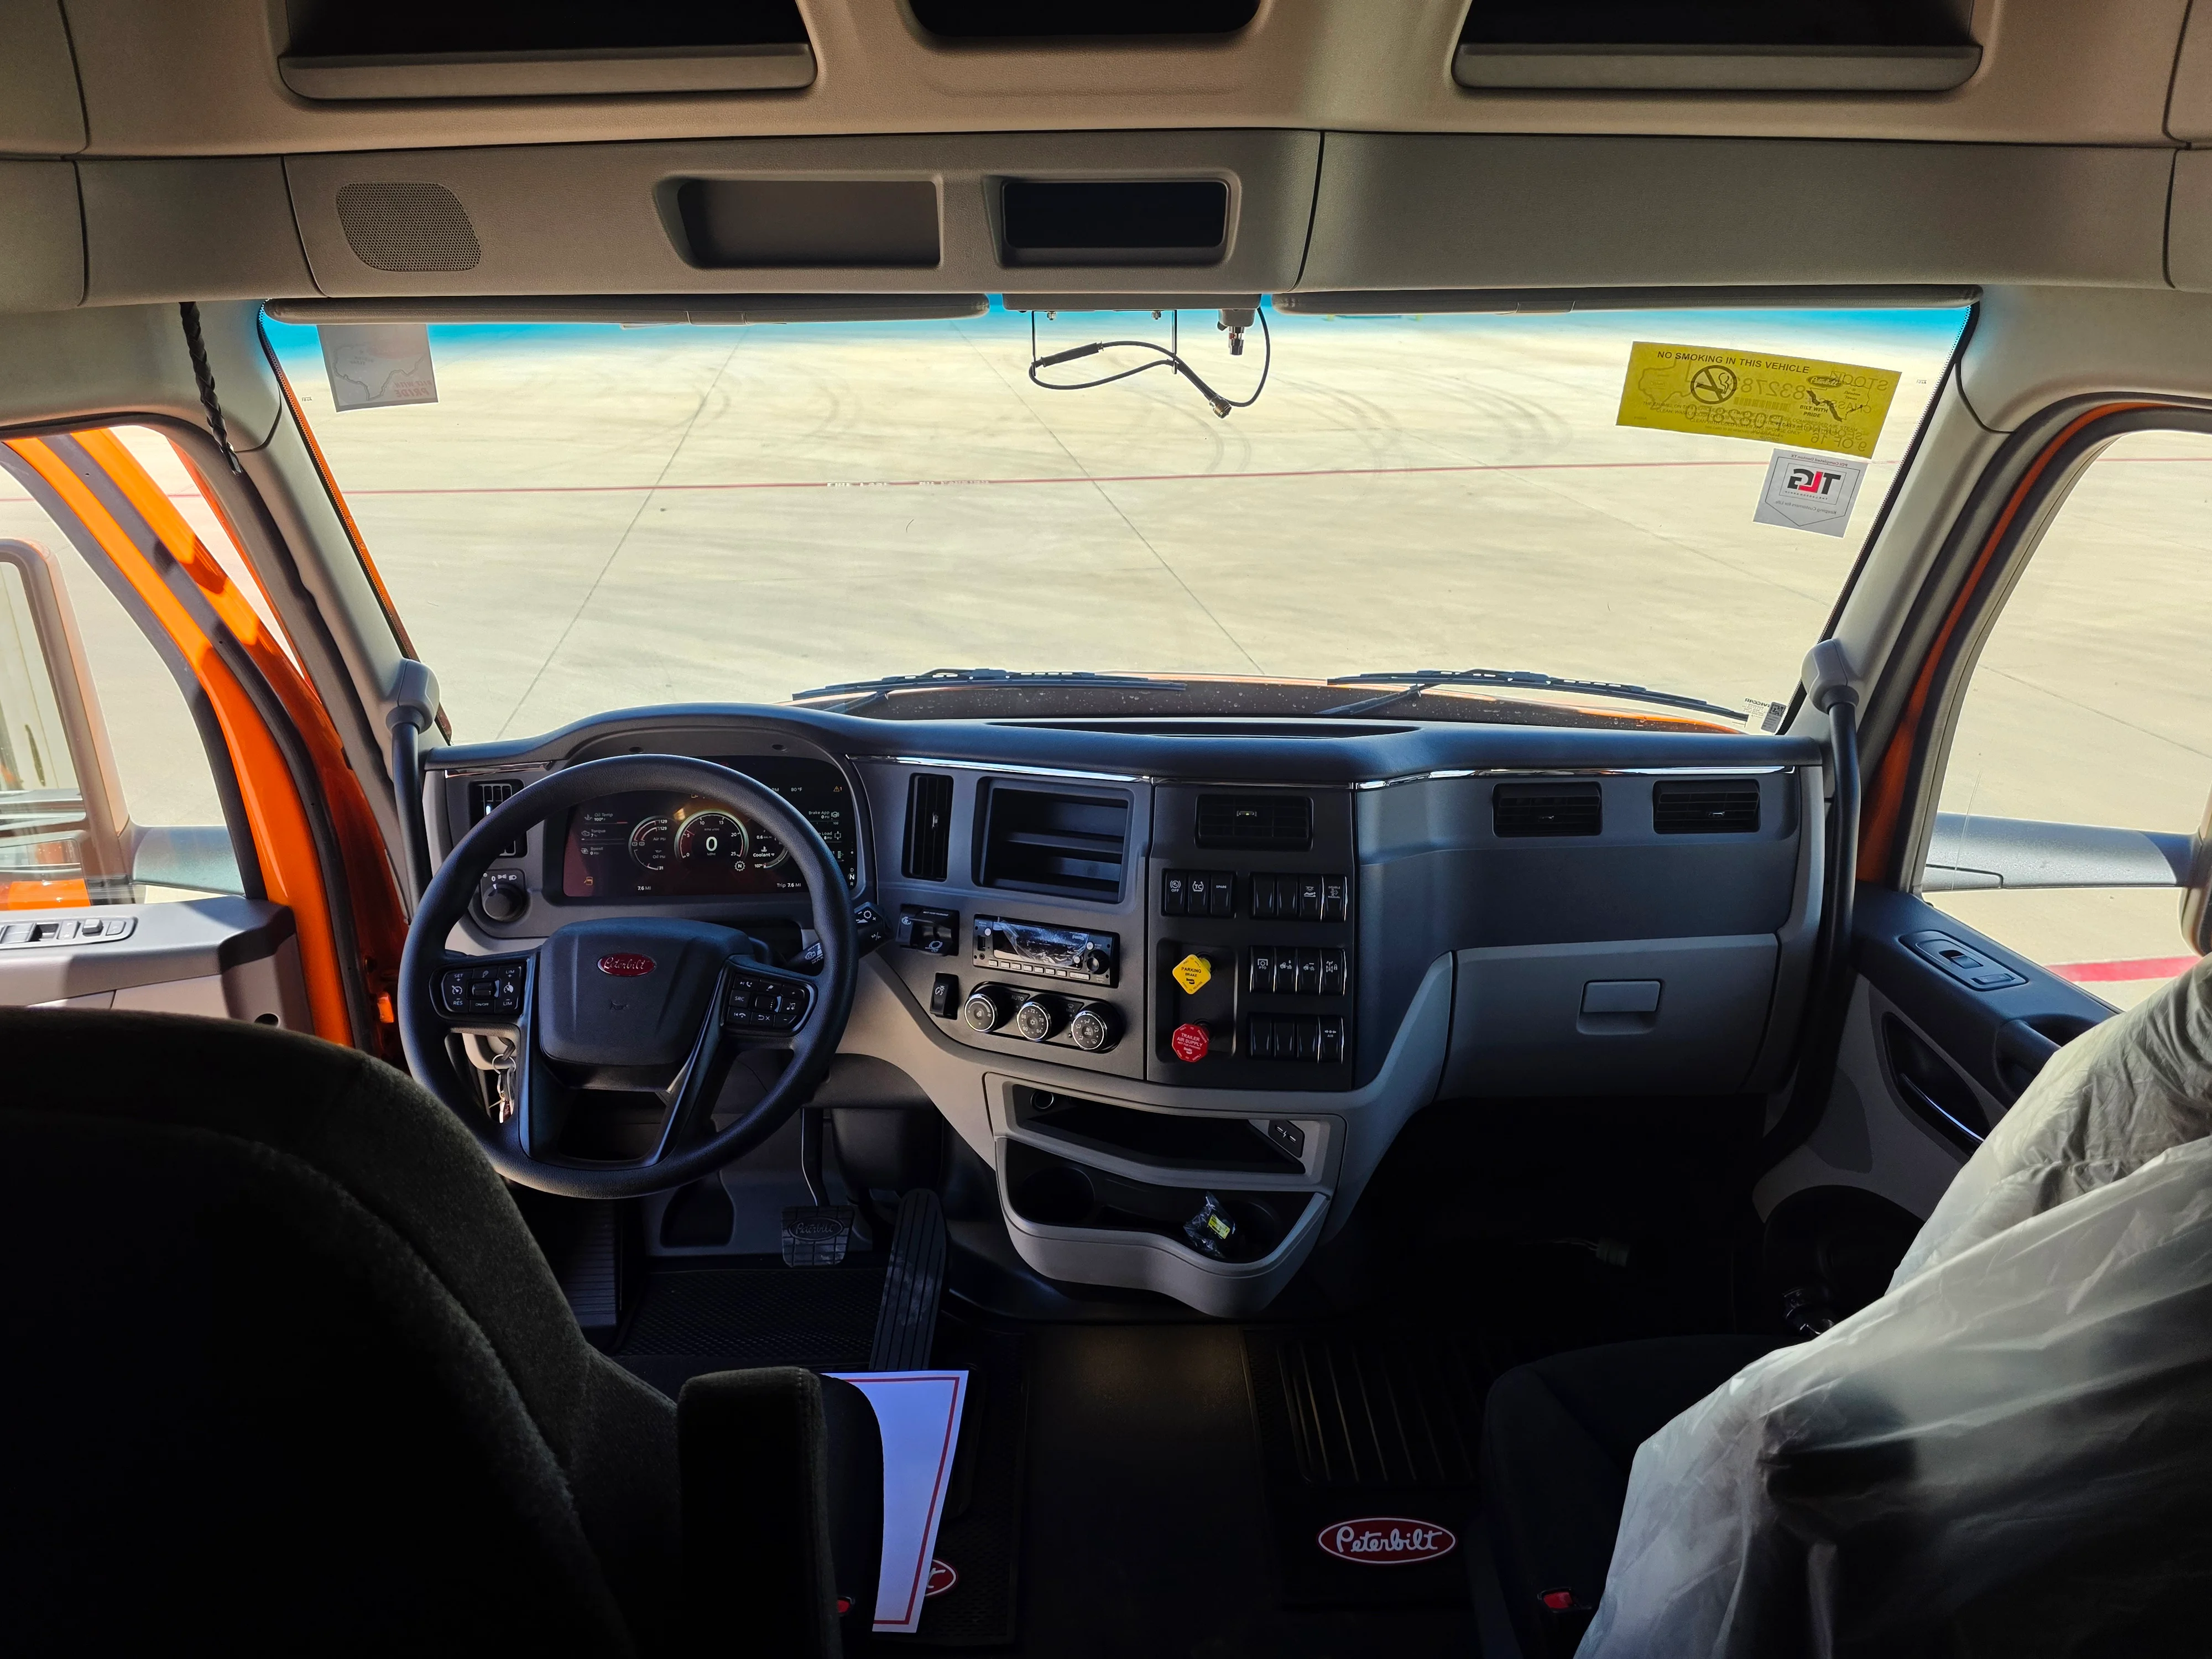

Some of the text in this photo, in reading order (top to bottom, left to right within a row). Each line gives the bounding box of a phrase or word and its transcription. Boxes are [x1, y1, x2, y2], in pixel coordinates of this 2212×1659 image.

[1675, 352, 1723, 363] SMOKING
[1725, 356, 1736, 364] IN
[1739, 358, 1761, 368] THIS
[1765, 361, 1810, 374] VEHICLE
[706, 836, 718, 852] 0
[1181, 1032, 1200, 1042] TRAILER
[1185, 1039, 1203, 1047] SUPPLY
[795, 1222, 838, 1234] Peterbilt
[1336, 1526, 1442, 1553] Peterbilt
